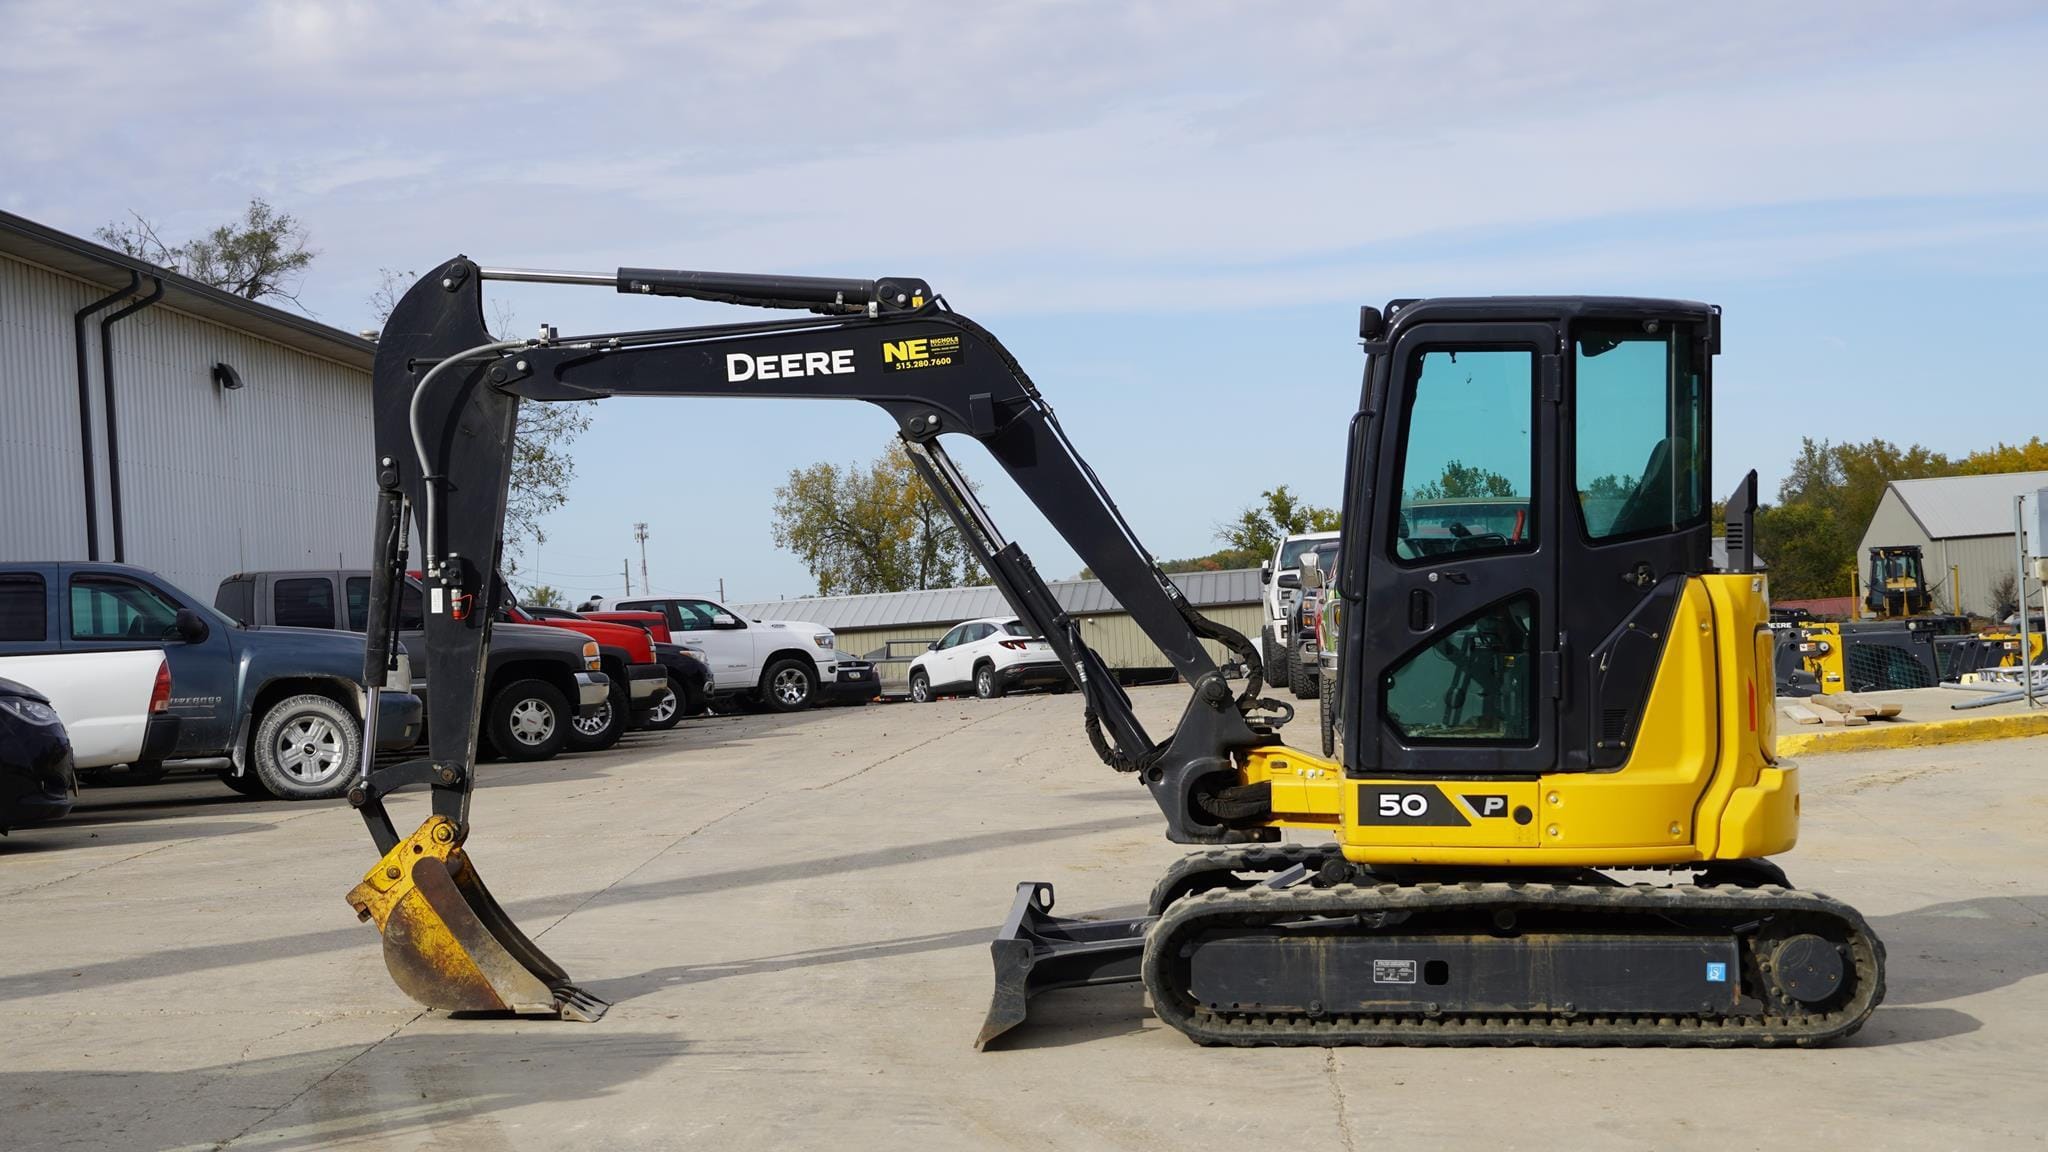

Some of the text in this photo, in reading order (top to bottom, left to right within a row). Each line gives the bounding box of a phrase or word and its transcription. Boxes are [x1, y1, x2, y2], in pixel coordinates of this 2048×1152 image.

[883, 338, 930, 363] NE
[930, 336, 959, 345] NICHOLS
[726, 349, 855, 382] DEERE
[895, 357, 952, 370] 515.280.7600
[1379, 794, 1428, 817] 50
[1483, 797, 1504, 816] P
